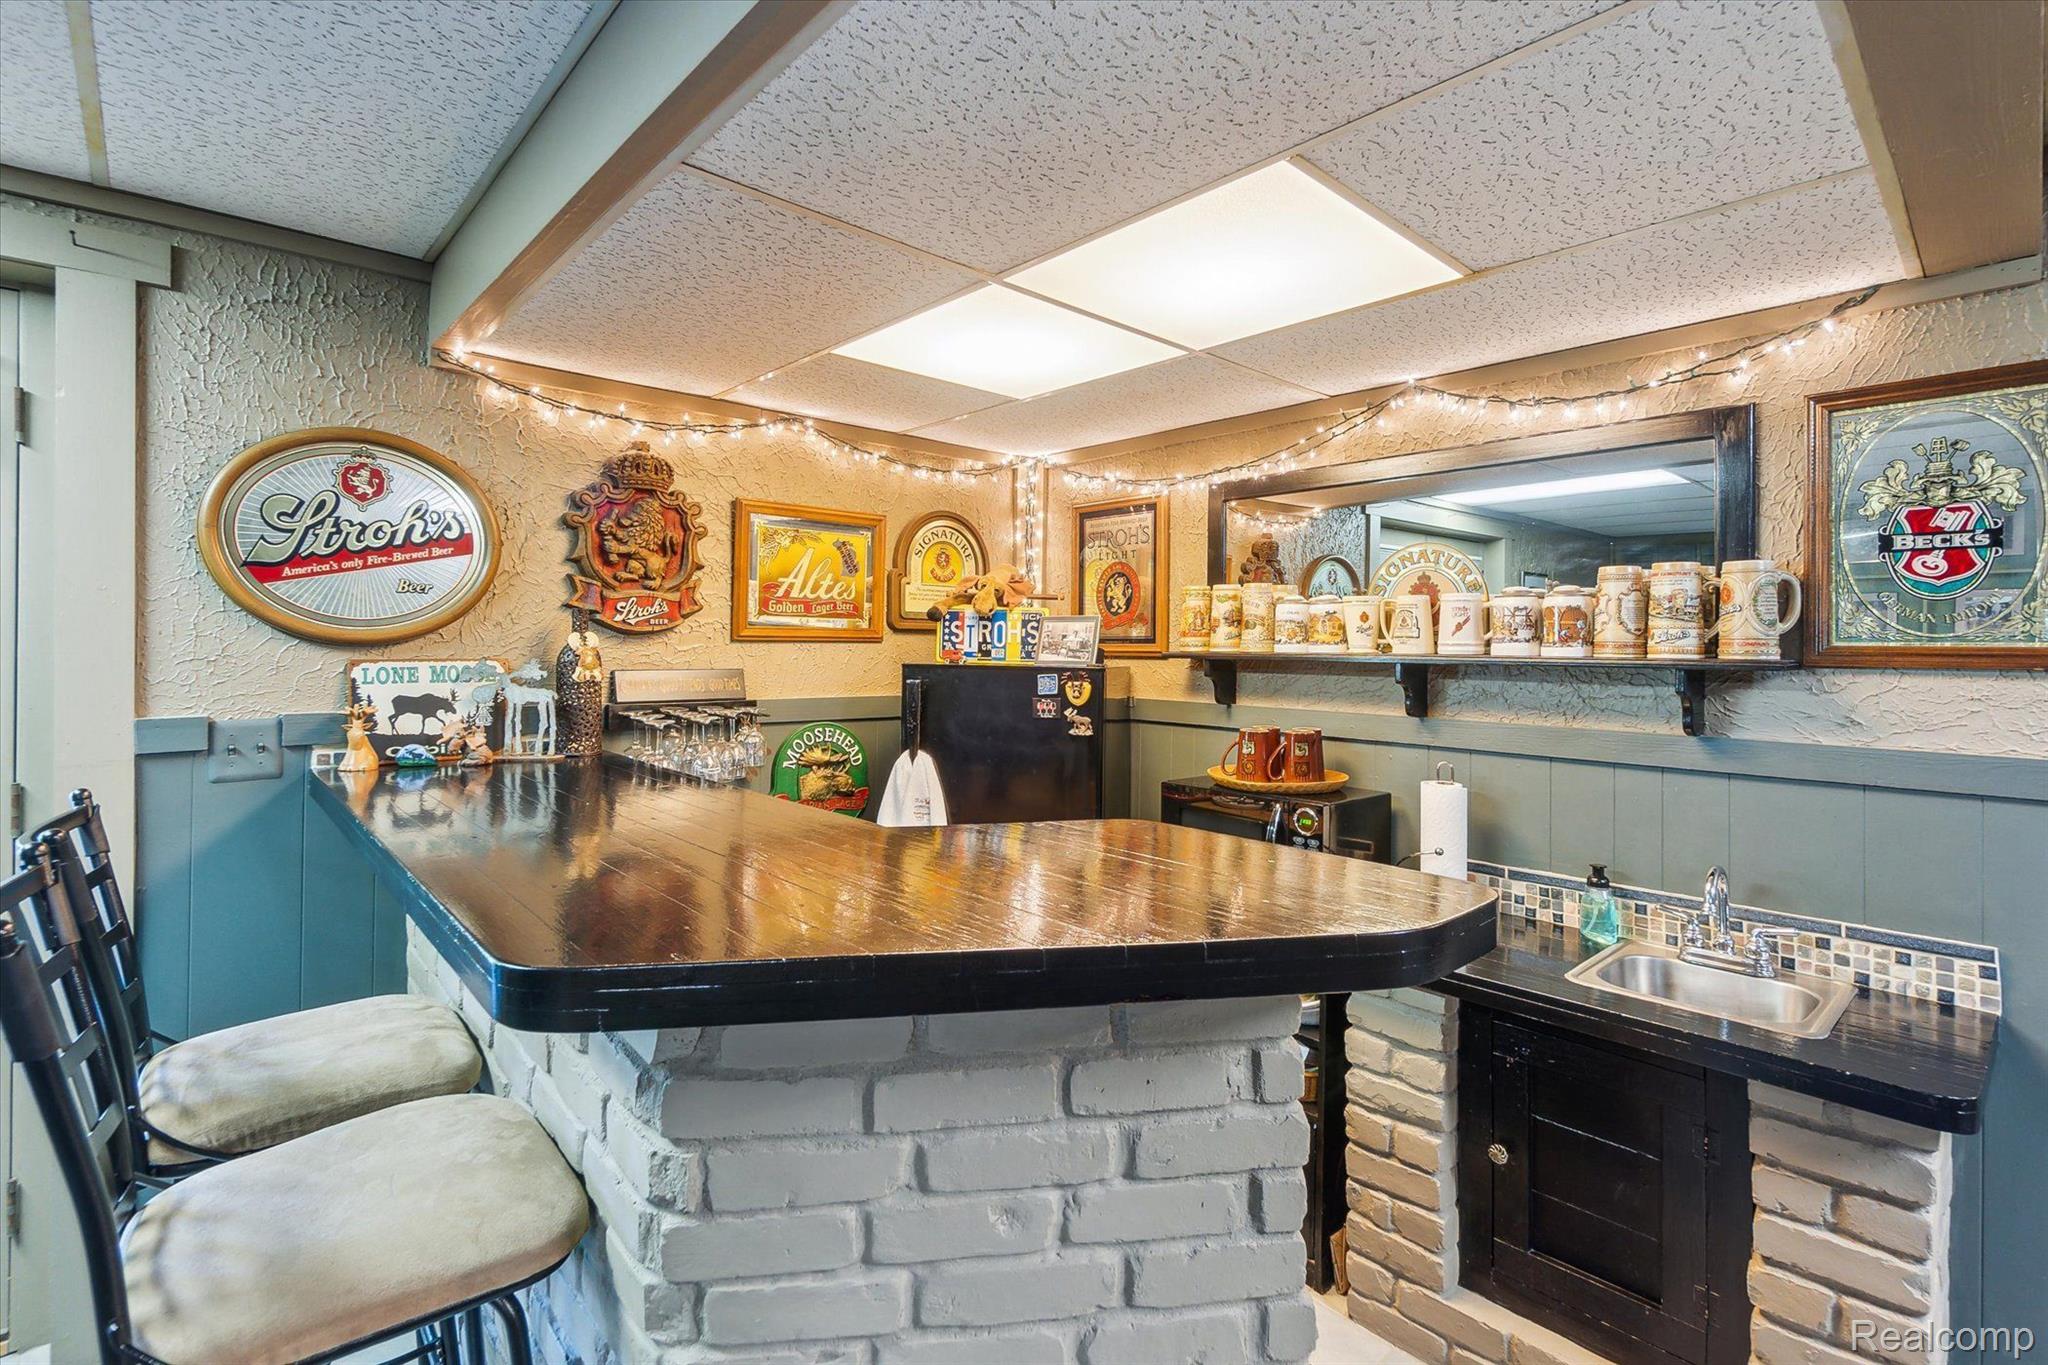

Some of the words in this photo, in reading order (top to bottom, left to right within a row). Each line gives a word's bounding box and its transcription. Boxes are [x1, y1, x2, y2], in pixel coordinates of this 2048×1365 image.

[240, 490, 464, 566] Stroh's
[1087, 524, 1151, 549] STROH'S
[1891, 529, 1990, 551] BECK'S
[281, 560, 339, 578] America's
[341, 558, 364, 570] only
[366, 549, 429, 566] Fire-Brewed
[430, 545, 455, 558] Beer
[841, 541, 859, 574] MICHIGAN
[914, 530, 973, 562] SIGNATURE
[1098, 549, 1137, 561] LIGHT
[396, 578, 433, 595] Beer
[775, 547, 856, 600] Altes
[1373, 549, 1483, 598] SIGNATURE
[613, 597, 669, 625] Stroh's
[768, 601, 805, 613] Golden
[811, 602, 834, 613] Lager
[836, 601, 854, 611] Beer
[1877, 591, 1937, 624] GERMAN
[1943, 591, 2002, 624] IMPORT
[361, 666, 420, 685] LONE
[429, 665, 497, 684] MOO
[782, 727, 863, 770] MOOSEHEAD
